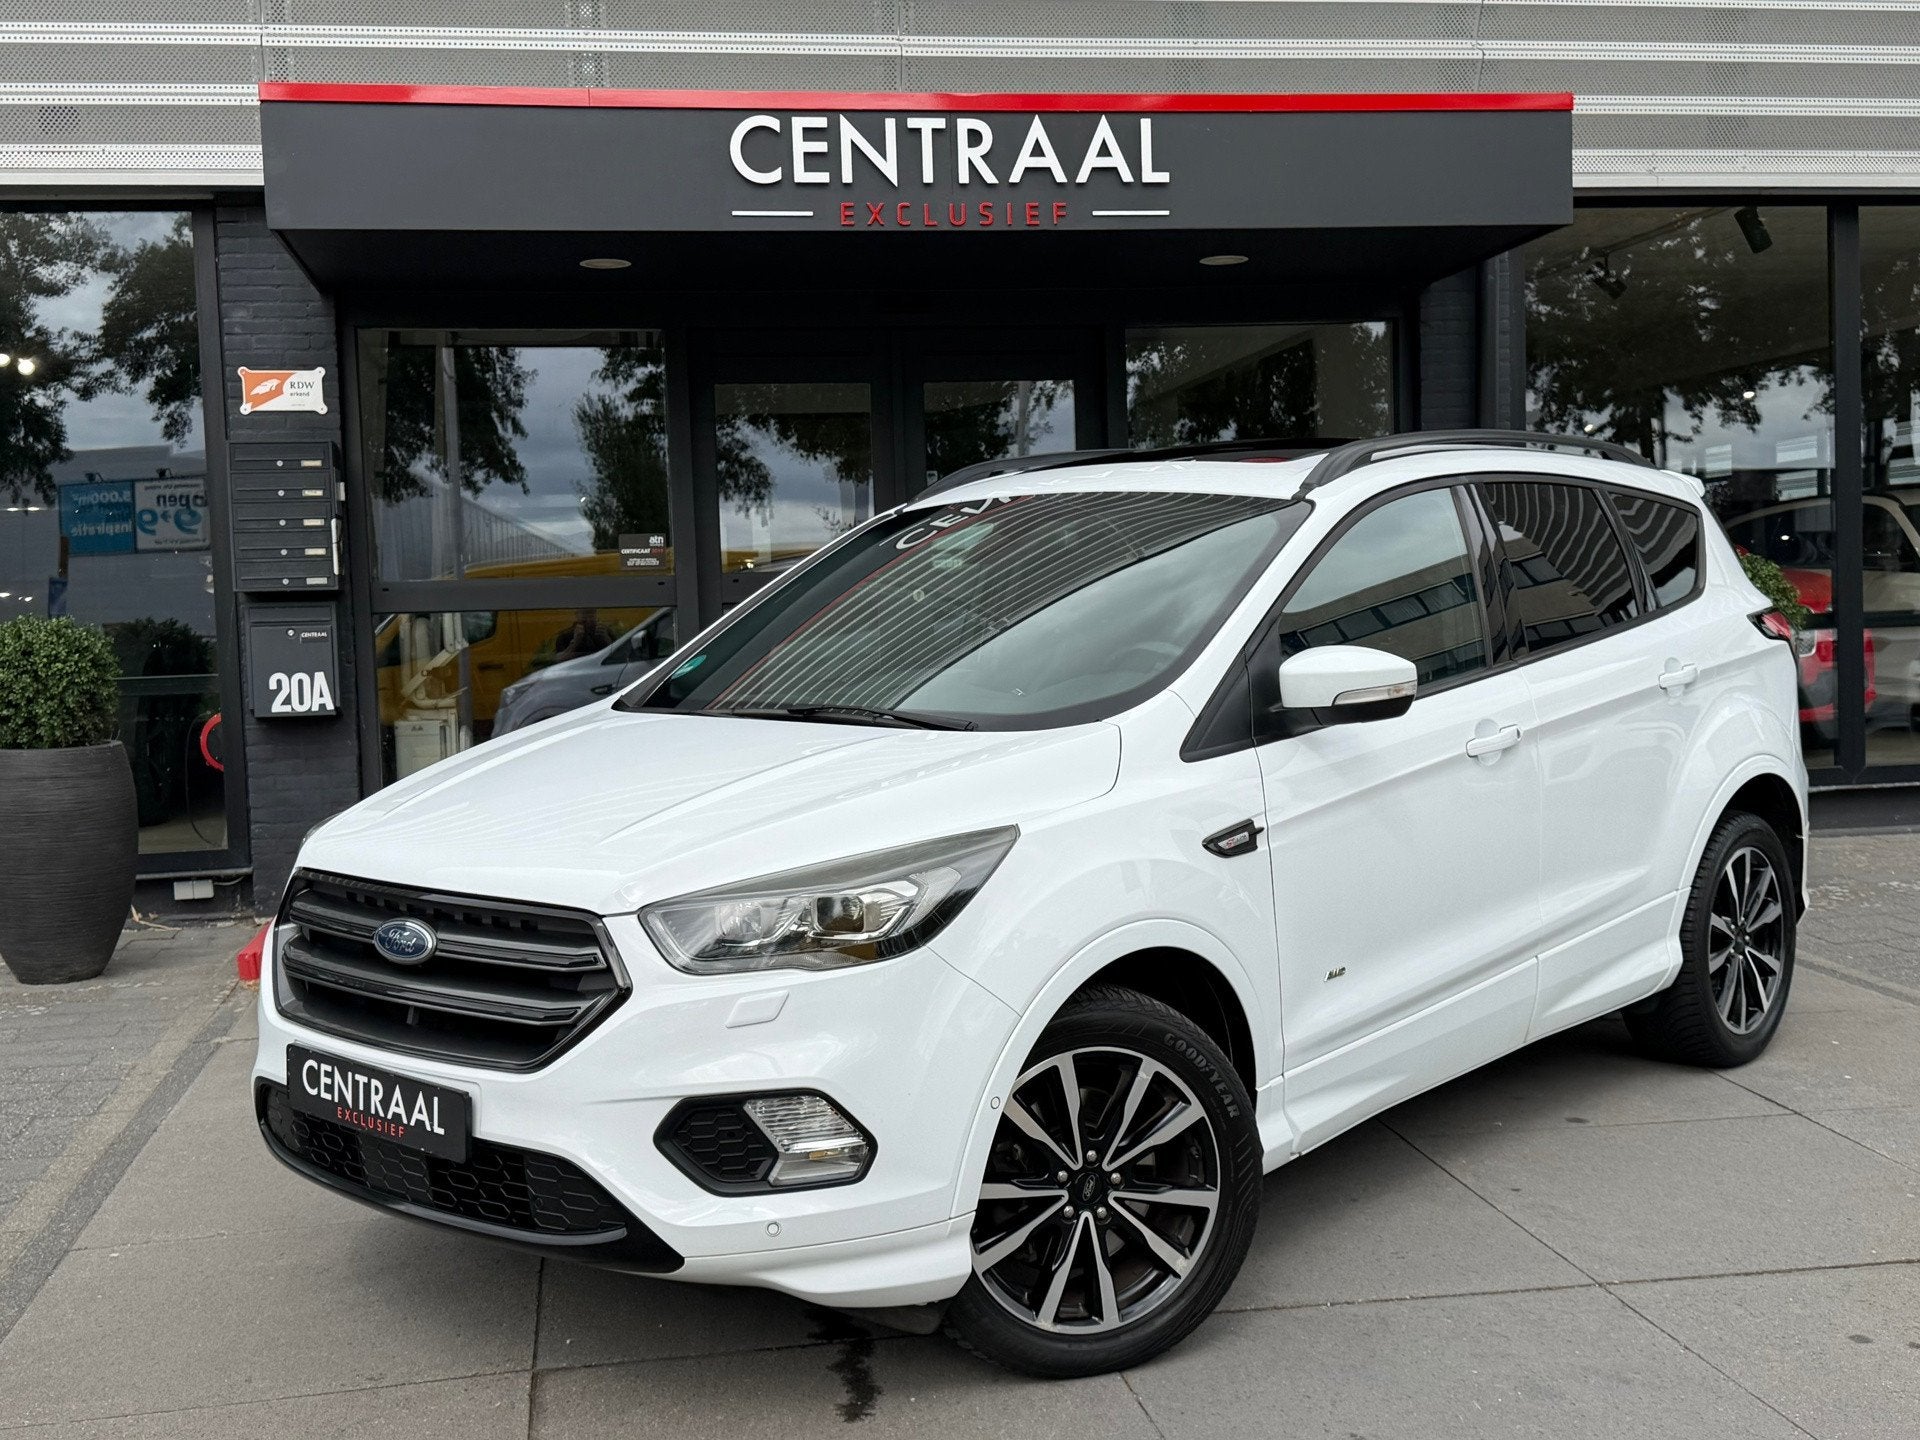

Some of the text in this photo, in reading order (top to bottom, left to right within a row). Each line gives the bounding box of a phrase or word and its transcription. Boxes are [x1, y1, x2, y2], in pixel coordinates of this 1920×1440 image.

[729, 114, 1170, 187] CENTRAAL
[840, 202, 1068, 227] EXCLUSIEF
[290, 381, 315, 389] RDW
[269, 671, 335, 713] 20A
[386, 928, 417, 952] Ford
[1164, 1033, 1240, 1118] GOODYEAR
[302, 1059, 445, 1135] CENTRAAL
[337, 1106, 405, 1138] EXCLUSIEF
